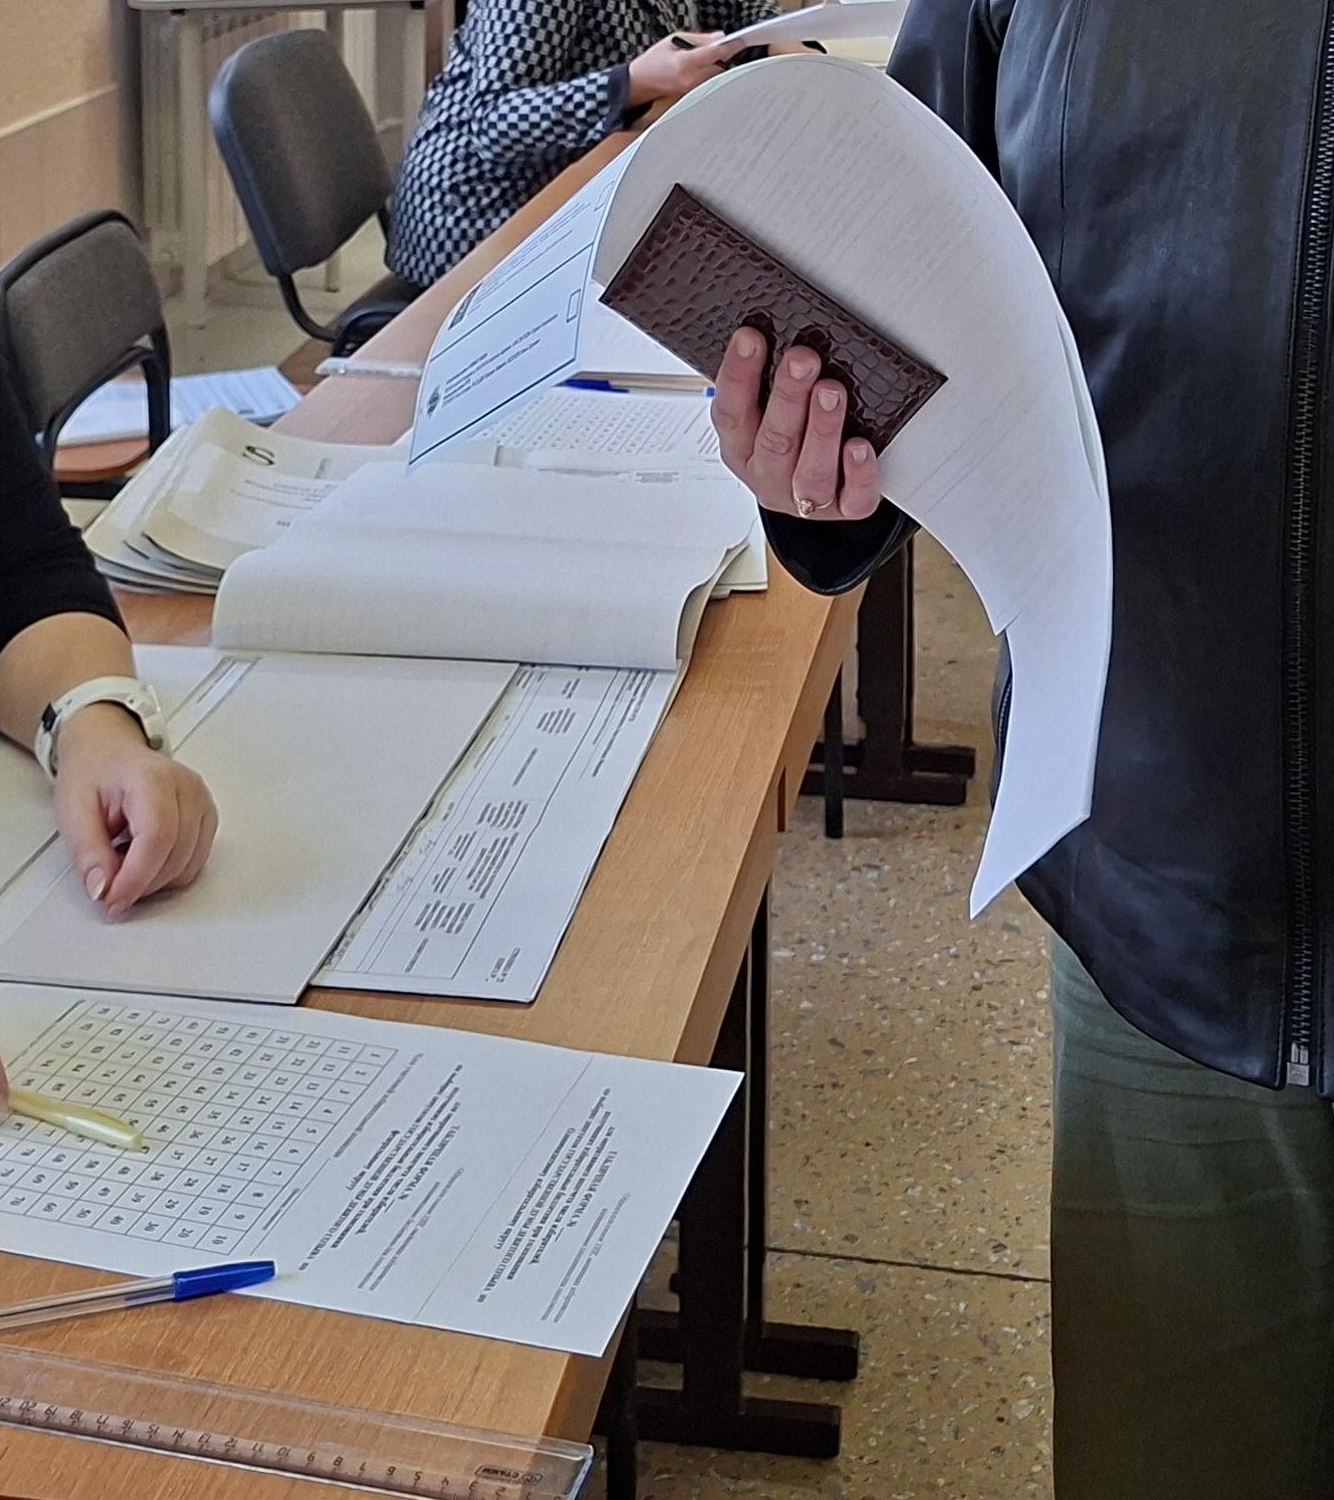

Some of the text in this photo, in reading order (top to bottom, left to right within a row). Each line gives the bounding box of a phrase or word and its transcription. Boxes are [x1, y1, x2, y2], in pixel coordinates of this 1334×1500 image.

[225, 1091, 239, 1099] 34
[257, 1096, 271, 1105] 24
[289, 1102, 303, 1110] 14
[207, 1110, 222, 1119] 35
[239, 1116, 254, 1125] 25
[272, 1121, 286, 1130] 15
[189, 1130, 203, 1139] 36
[221, 1136, 236, 1145] 26
[254, 1142, 268, 1150] 16
[76, 1086, 207, 1218] 44 45 46 48 49 50
[171, 1150, 185, 1160] 37
[203, 1156, 218, 1166] 27
[237, 1163, 250, 1172] 17
[150, 1171, 165, 1181] 38
[183, 1178, 198, 1187] 28
[217, 1184, 231, 1193] 18
[131, 1193, 145, 1202] 39
[165, 1199, 179, 1209] 29
[198, 1206, 212, 1215] 19
[110, 1216, 124, 1225] 40
[144, 1222, 159, 1231] 30
[178, 1228, 194, 1238] 20
[212, 1236, 227, 1244] 10
